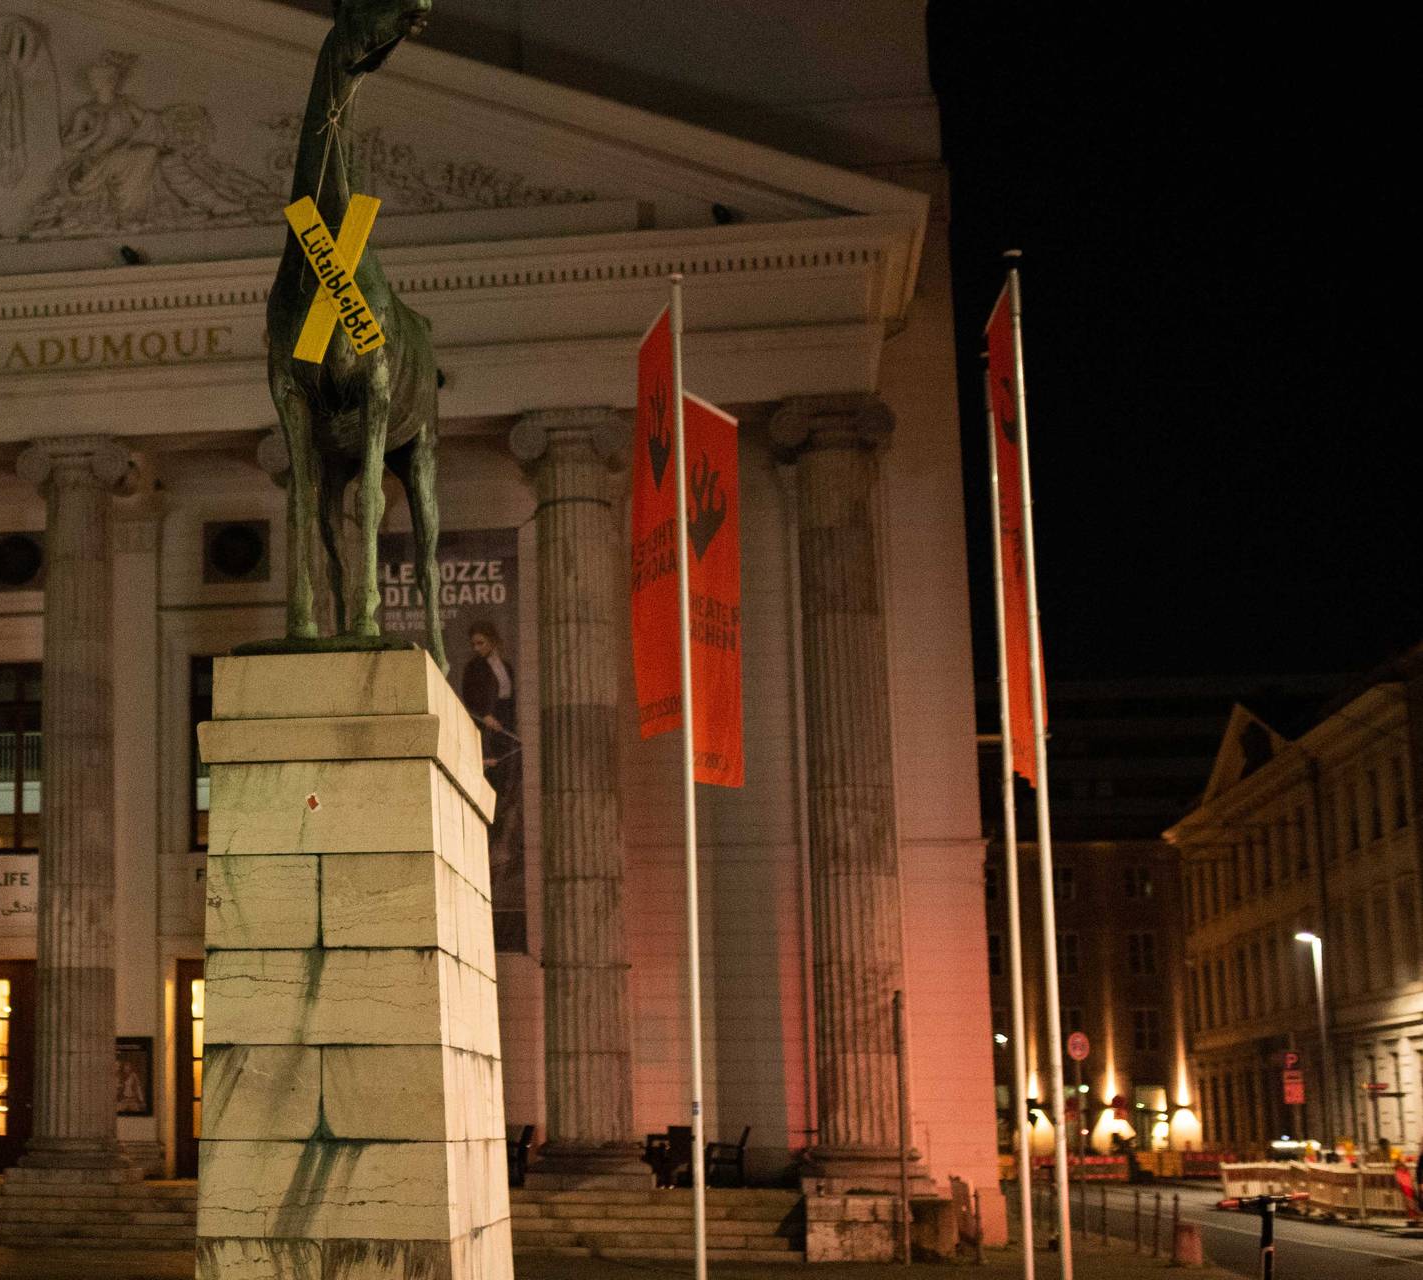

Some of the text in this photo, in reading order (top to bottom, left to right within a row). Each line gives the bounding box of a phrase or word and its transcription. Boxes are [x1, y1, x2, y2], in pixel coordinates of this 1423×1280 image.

[384, 560, 503, 584] LE OZZE
[384, 583, 506, 608] DI GARO
